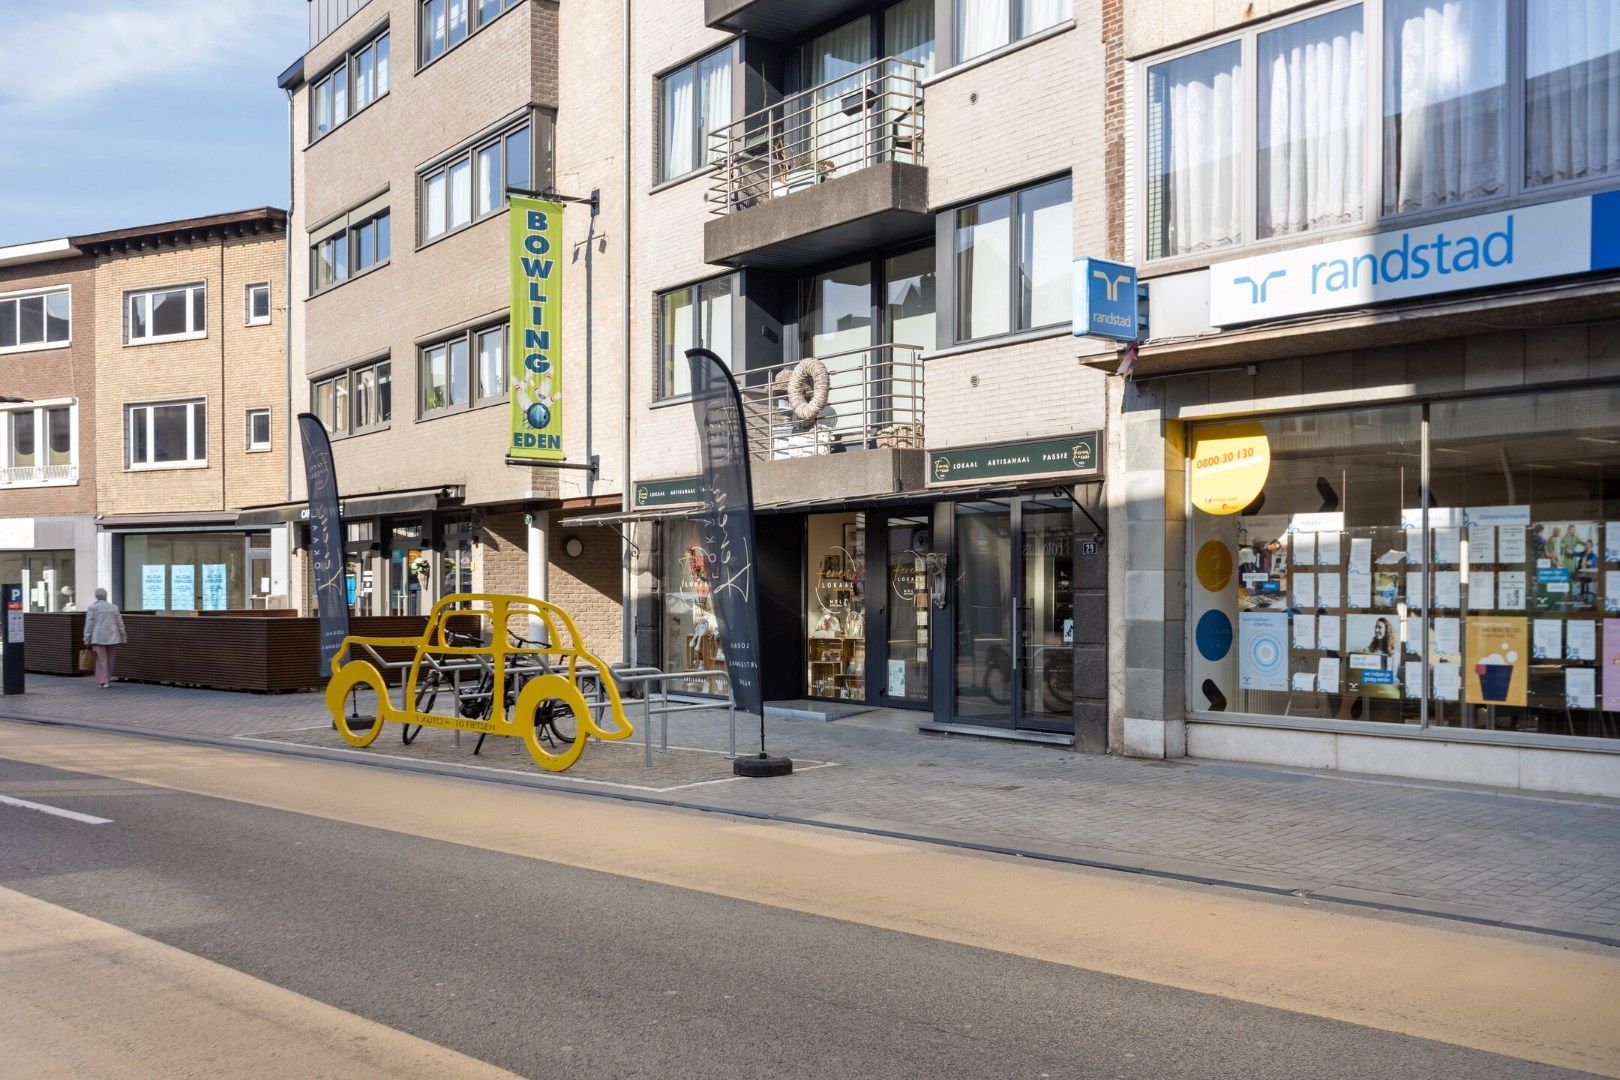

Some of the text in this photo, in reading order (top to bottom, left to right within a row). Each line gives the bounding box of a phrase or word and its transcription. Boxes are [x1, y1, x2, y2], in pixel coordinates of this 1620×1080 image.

[1311, 214, 1514, 295] randstad
[520, 210, 553, 375] BOWLING
[1093, 312, 1131, 328] randstad
[513, 432, 561, 449] EDEN
[953, 461, 978, 470] LOKAAL
[987, 456, 1031, 466] ARTISANAAL
[1042, 452, 1068, 461] PASSIE
[1196, 447, 1254, 469] 0800 30 130
[1085, 544, 1094, 553] 29
[11, 589, 20, 601] P
[421, 716, 442, 725] AUTO
[466, 720, 496, 731] FIETSEN
